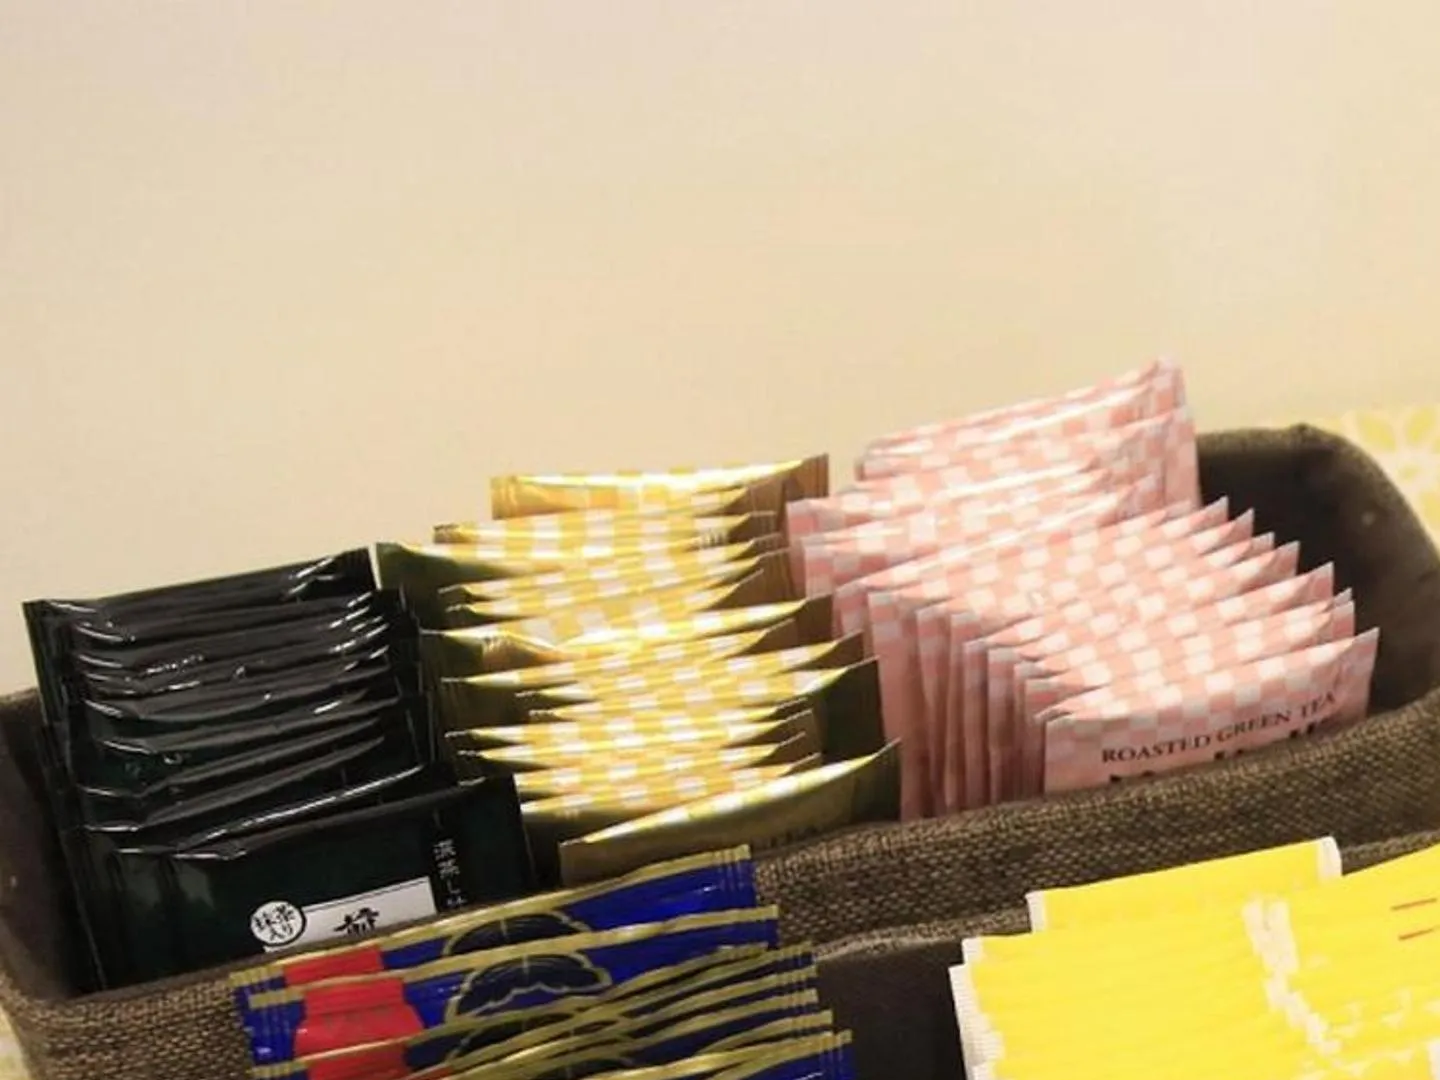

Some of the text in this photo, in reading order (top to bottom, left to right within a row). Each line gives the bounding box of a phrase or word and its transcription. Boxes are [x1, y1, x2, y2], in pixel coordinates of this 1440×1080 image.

[1102, 734, 1211, 764] ROASTED
[1217, 709, 1292, 743] GREEN
[1301, 691, 1336, 718] TEA
